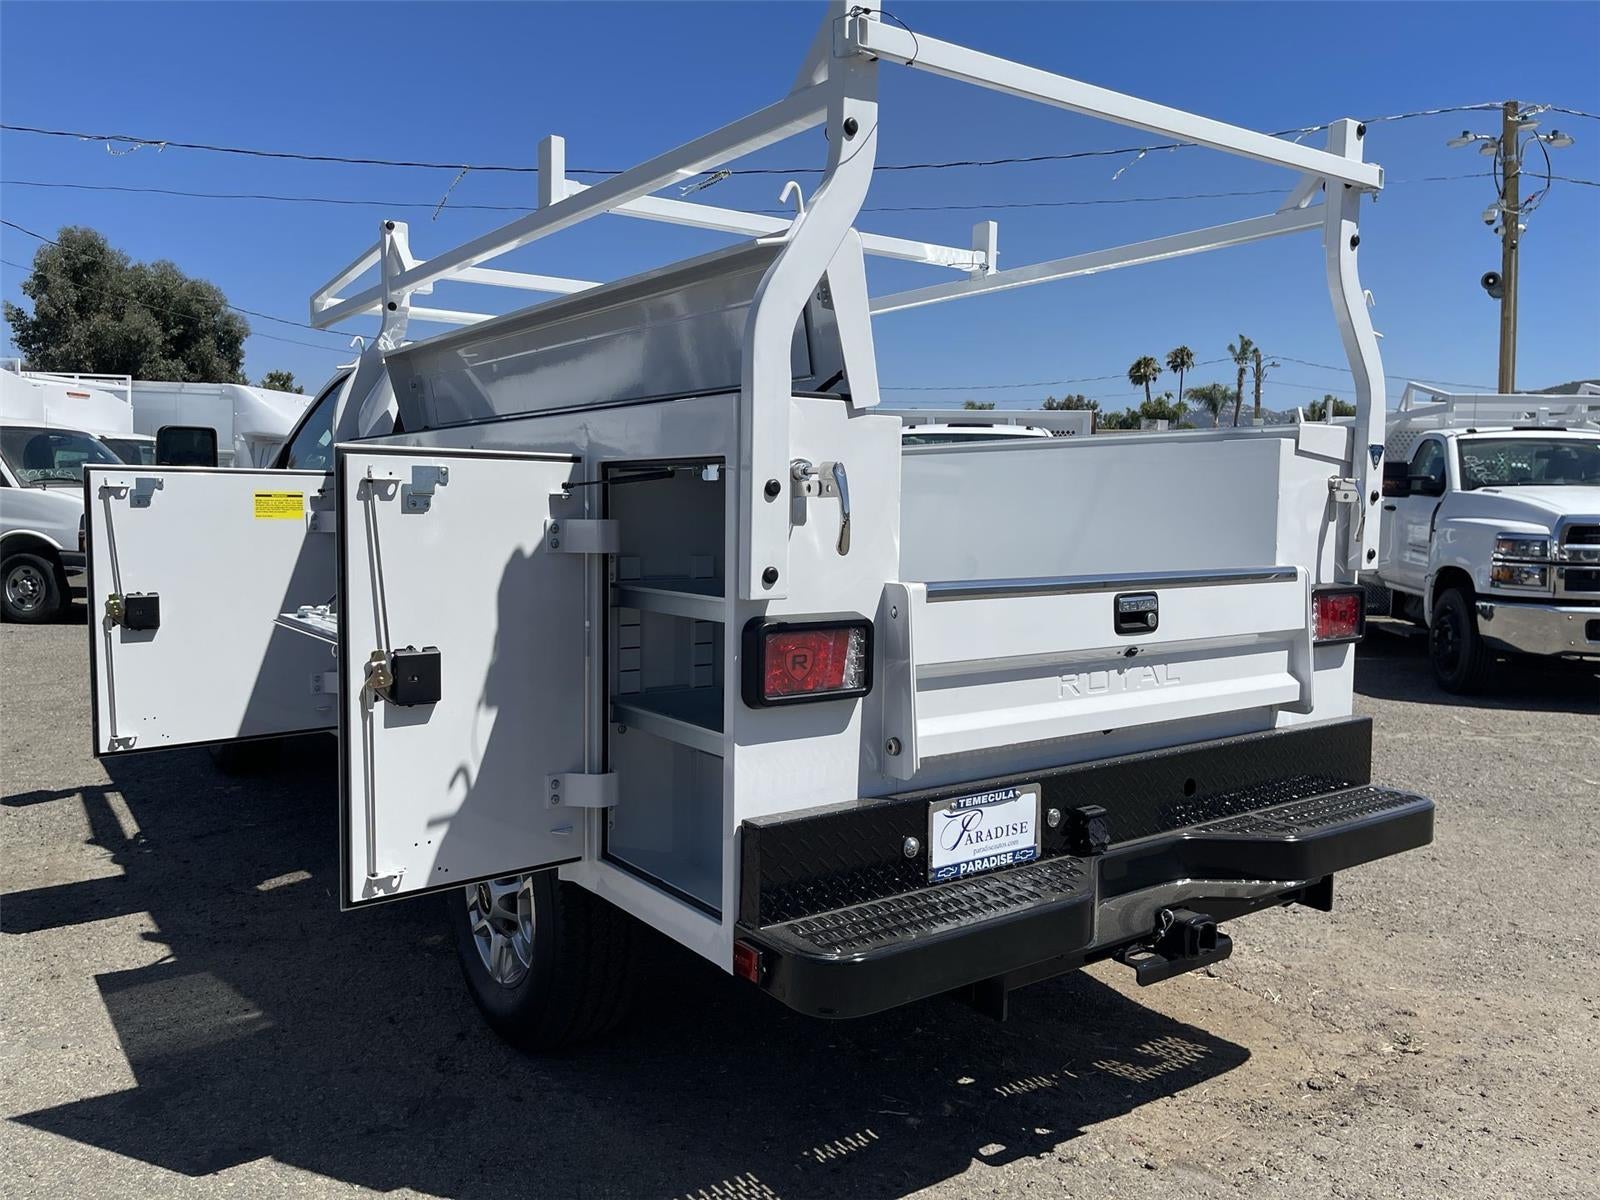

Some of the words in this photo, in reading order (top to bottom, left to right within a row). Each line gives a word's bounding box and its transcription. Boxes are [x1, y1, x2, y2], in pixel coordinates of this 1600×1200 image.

[791, 654, 808, 670] R
[1056, 663, 1181, 699] ROYAL
[958, 790, 1015, 808] TEMECULA
[959, 852, 1014, 874] PARADISE
